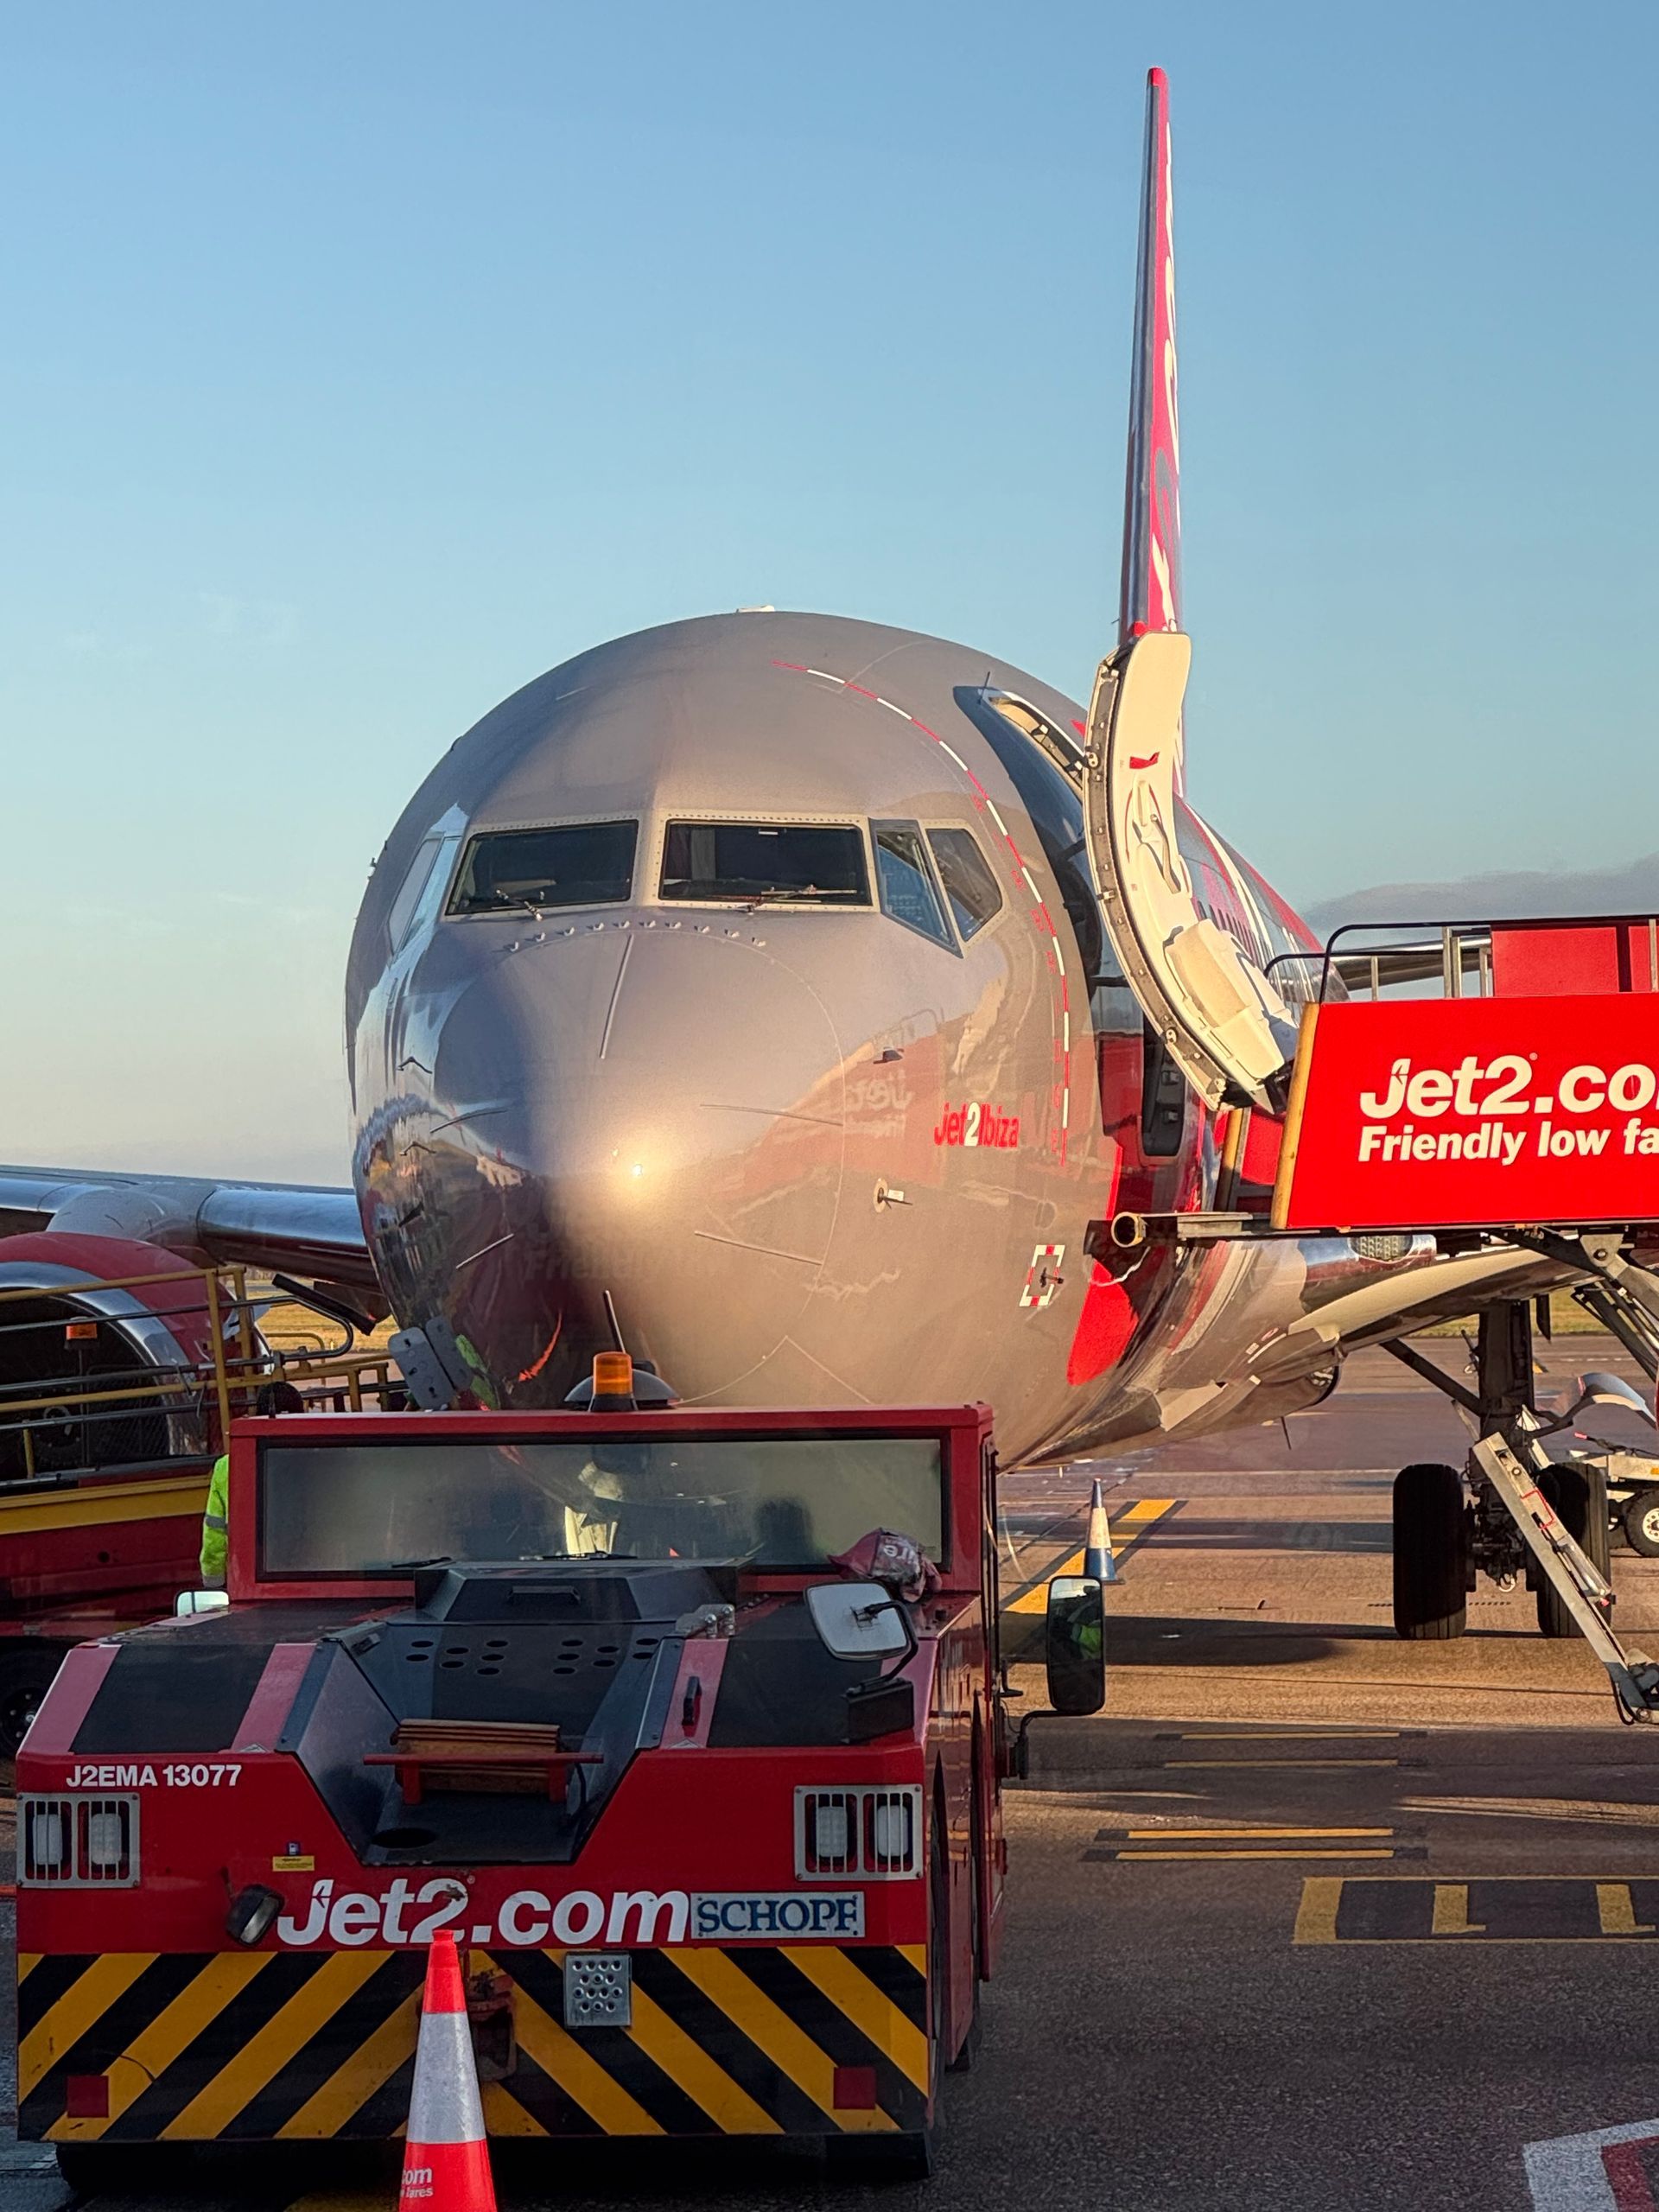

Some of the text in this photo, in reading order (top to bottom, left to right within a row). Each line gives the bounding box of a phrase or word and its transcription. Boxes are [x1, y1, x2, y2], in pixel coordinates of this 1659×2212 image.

[1360, 1056, 1659, 1118] Jet2.co
[1358, 1118, 1659, 1166] Friendly low fa
[67, 1764, 242, 1787] J2EMA 13077
[277, 1878, 689, 1945] Jet2.com
[698, 1899, 858, 1932] SCHOPF
